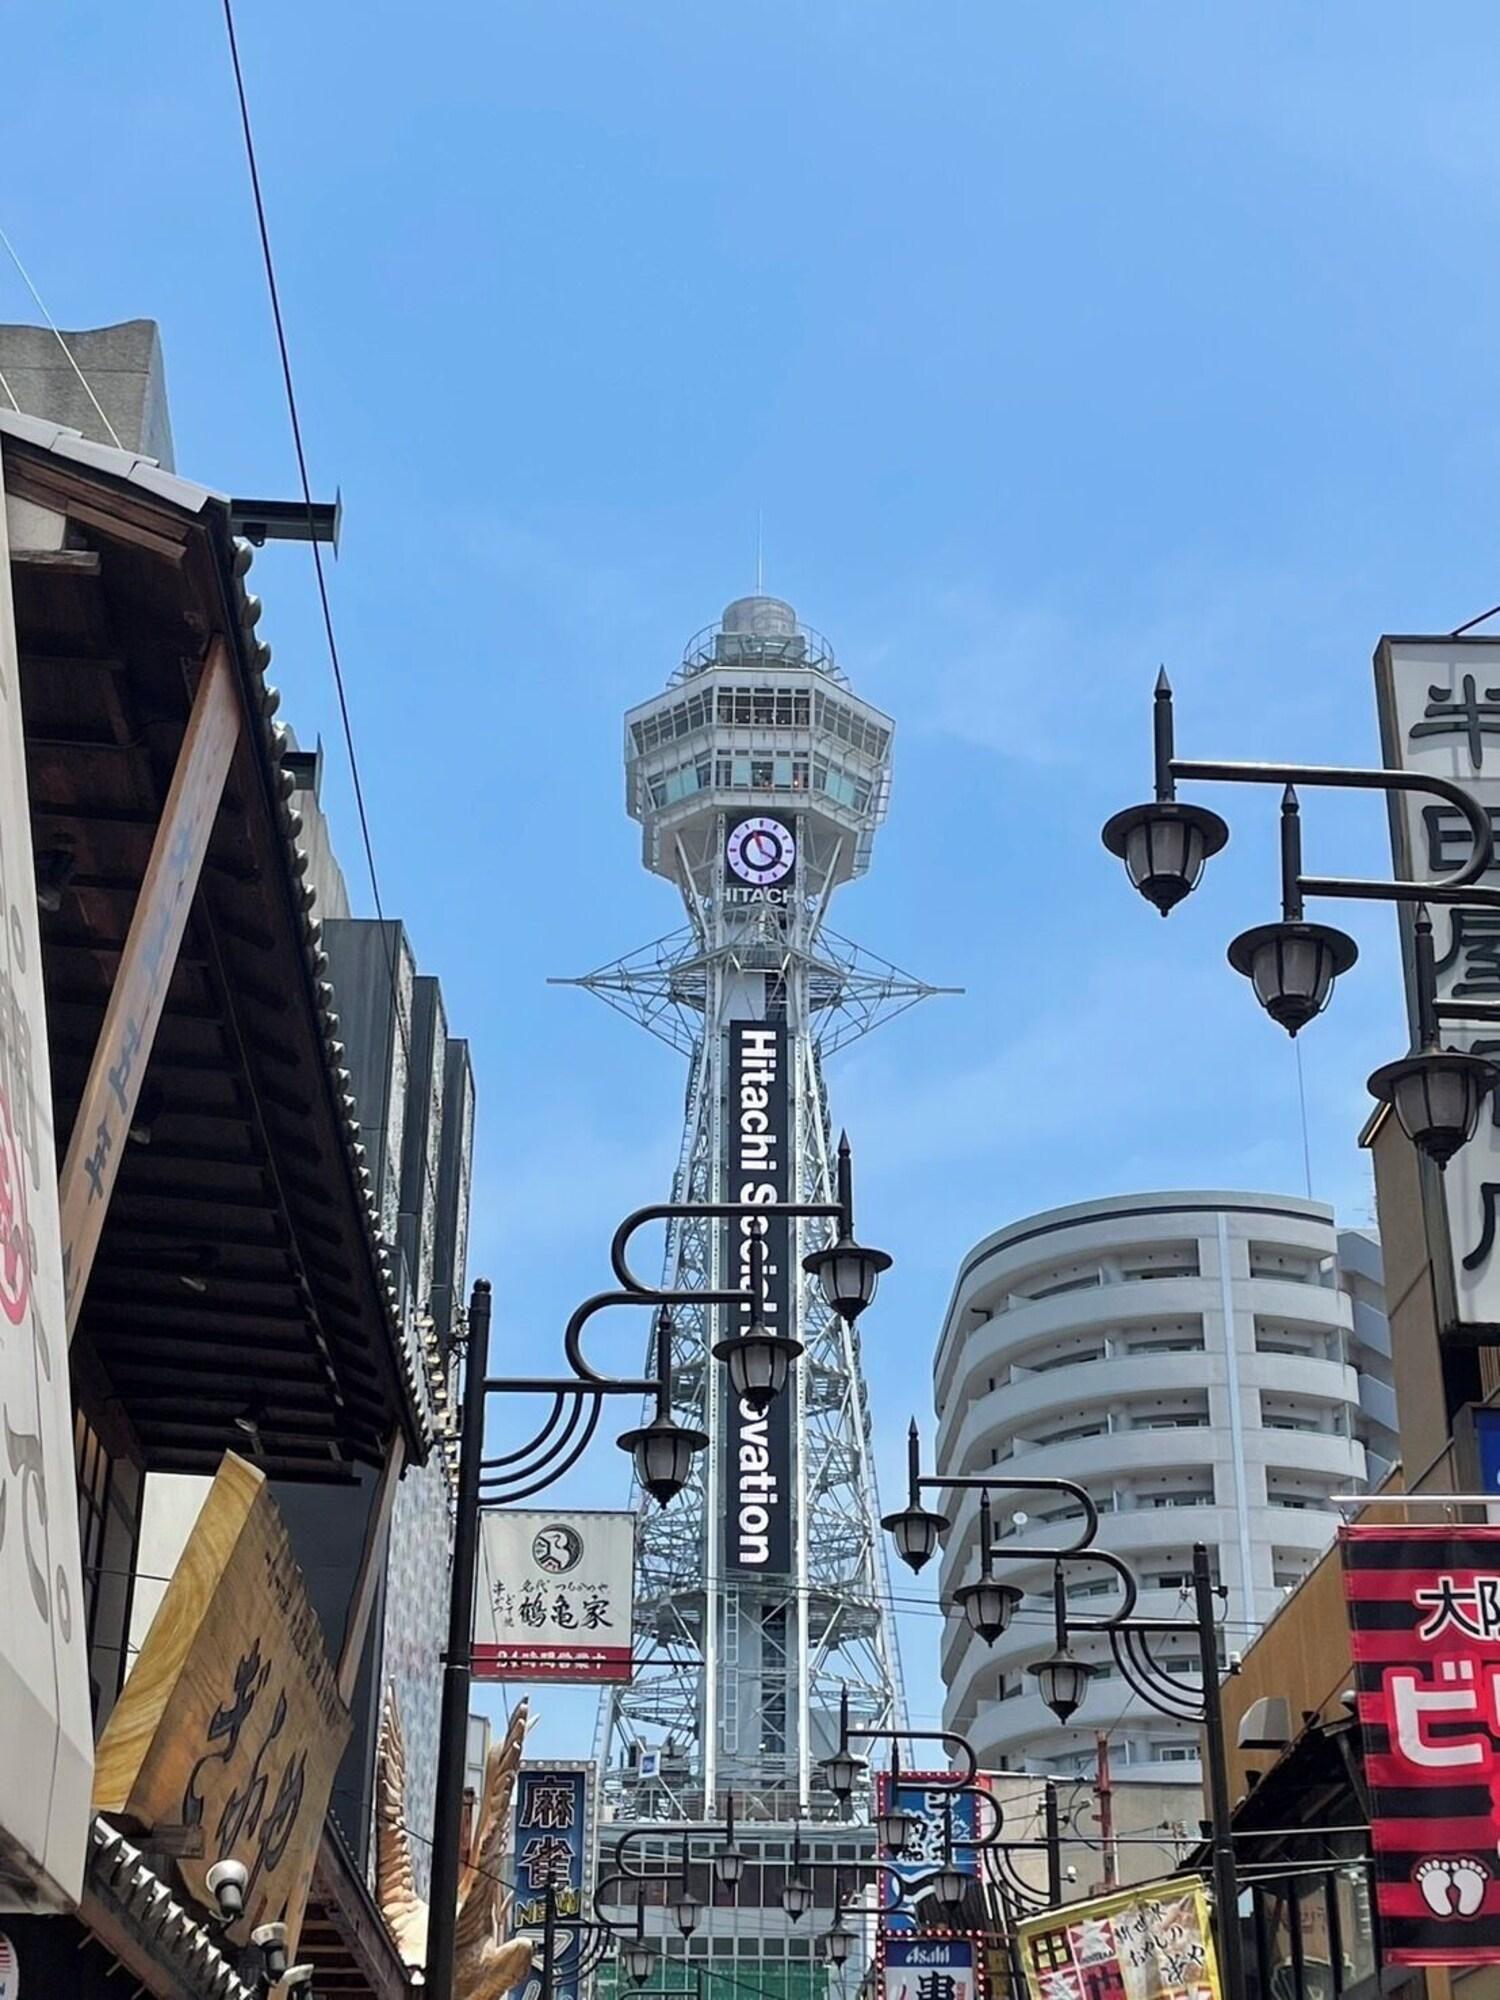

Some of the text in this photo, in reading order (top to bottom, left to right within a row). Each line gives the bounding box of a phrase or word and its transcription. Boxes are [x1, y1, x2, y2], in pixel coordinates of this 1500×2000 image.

[739, 1029, 778, 1171] Hitachi
[739, 1326, 778, 1564] ovation
[518, 1592, 614, 1630] 鶴亀家
[1391, 1659, 1500, 1768] ビ
[517, 1775, 575, 1889] 麻雀
[514, 1886, 581, 1929] NEW
[905, 1945, 950, 1965] Asahi
